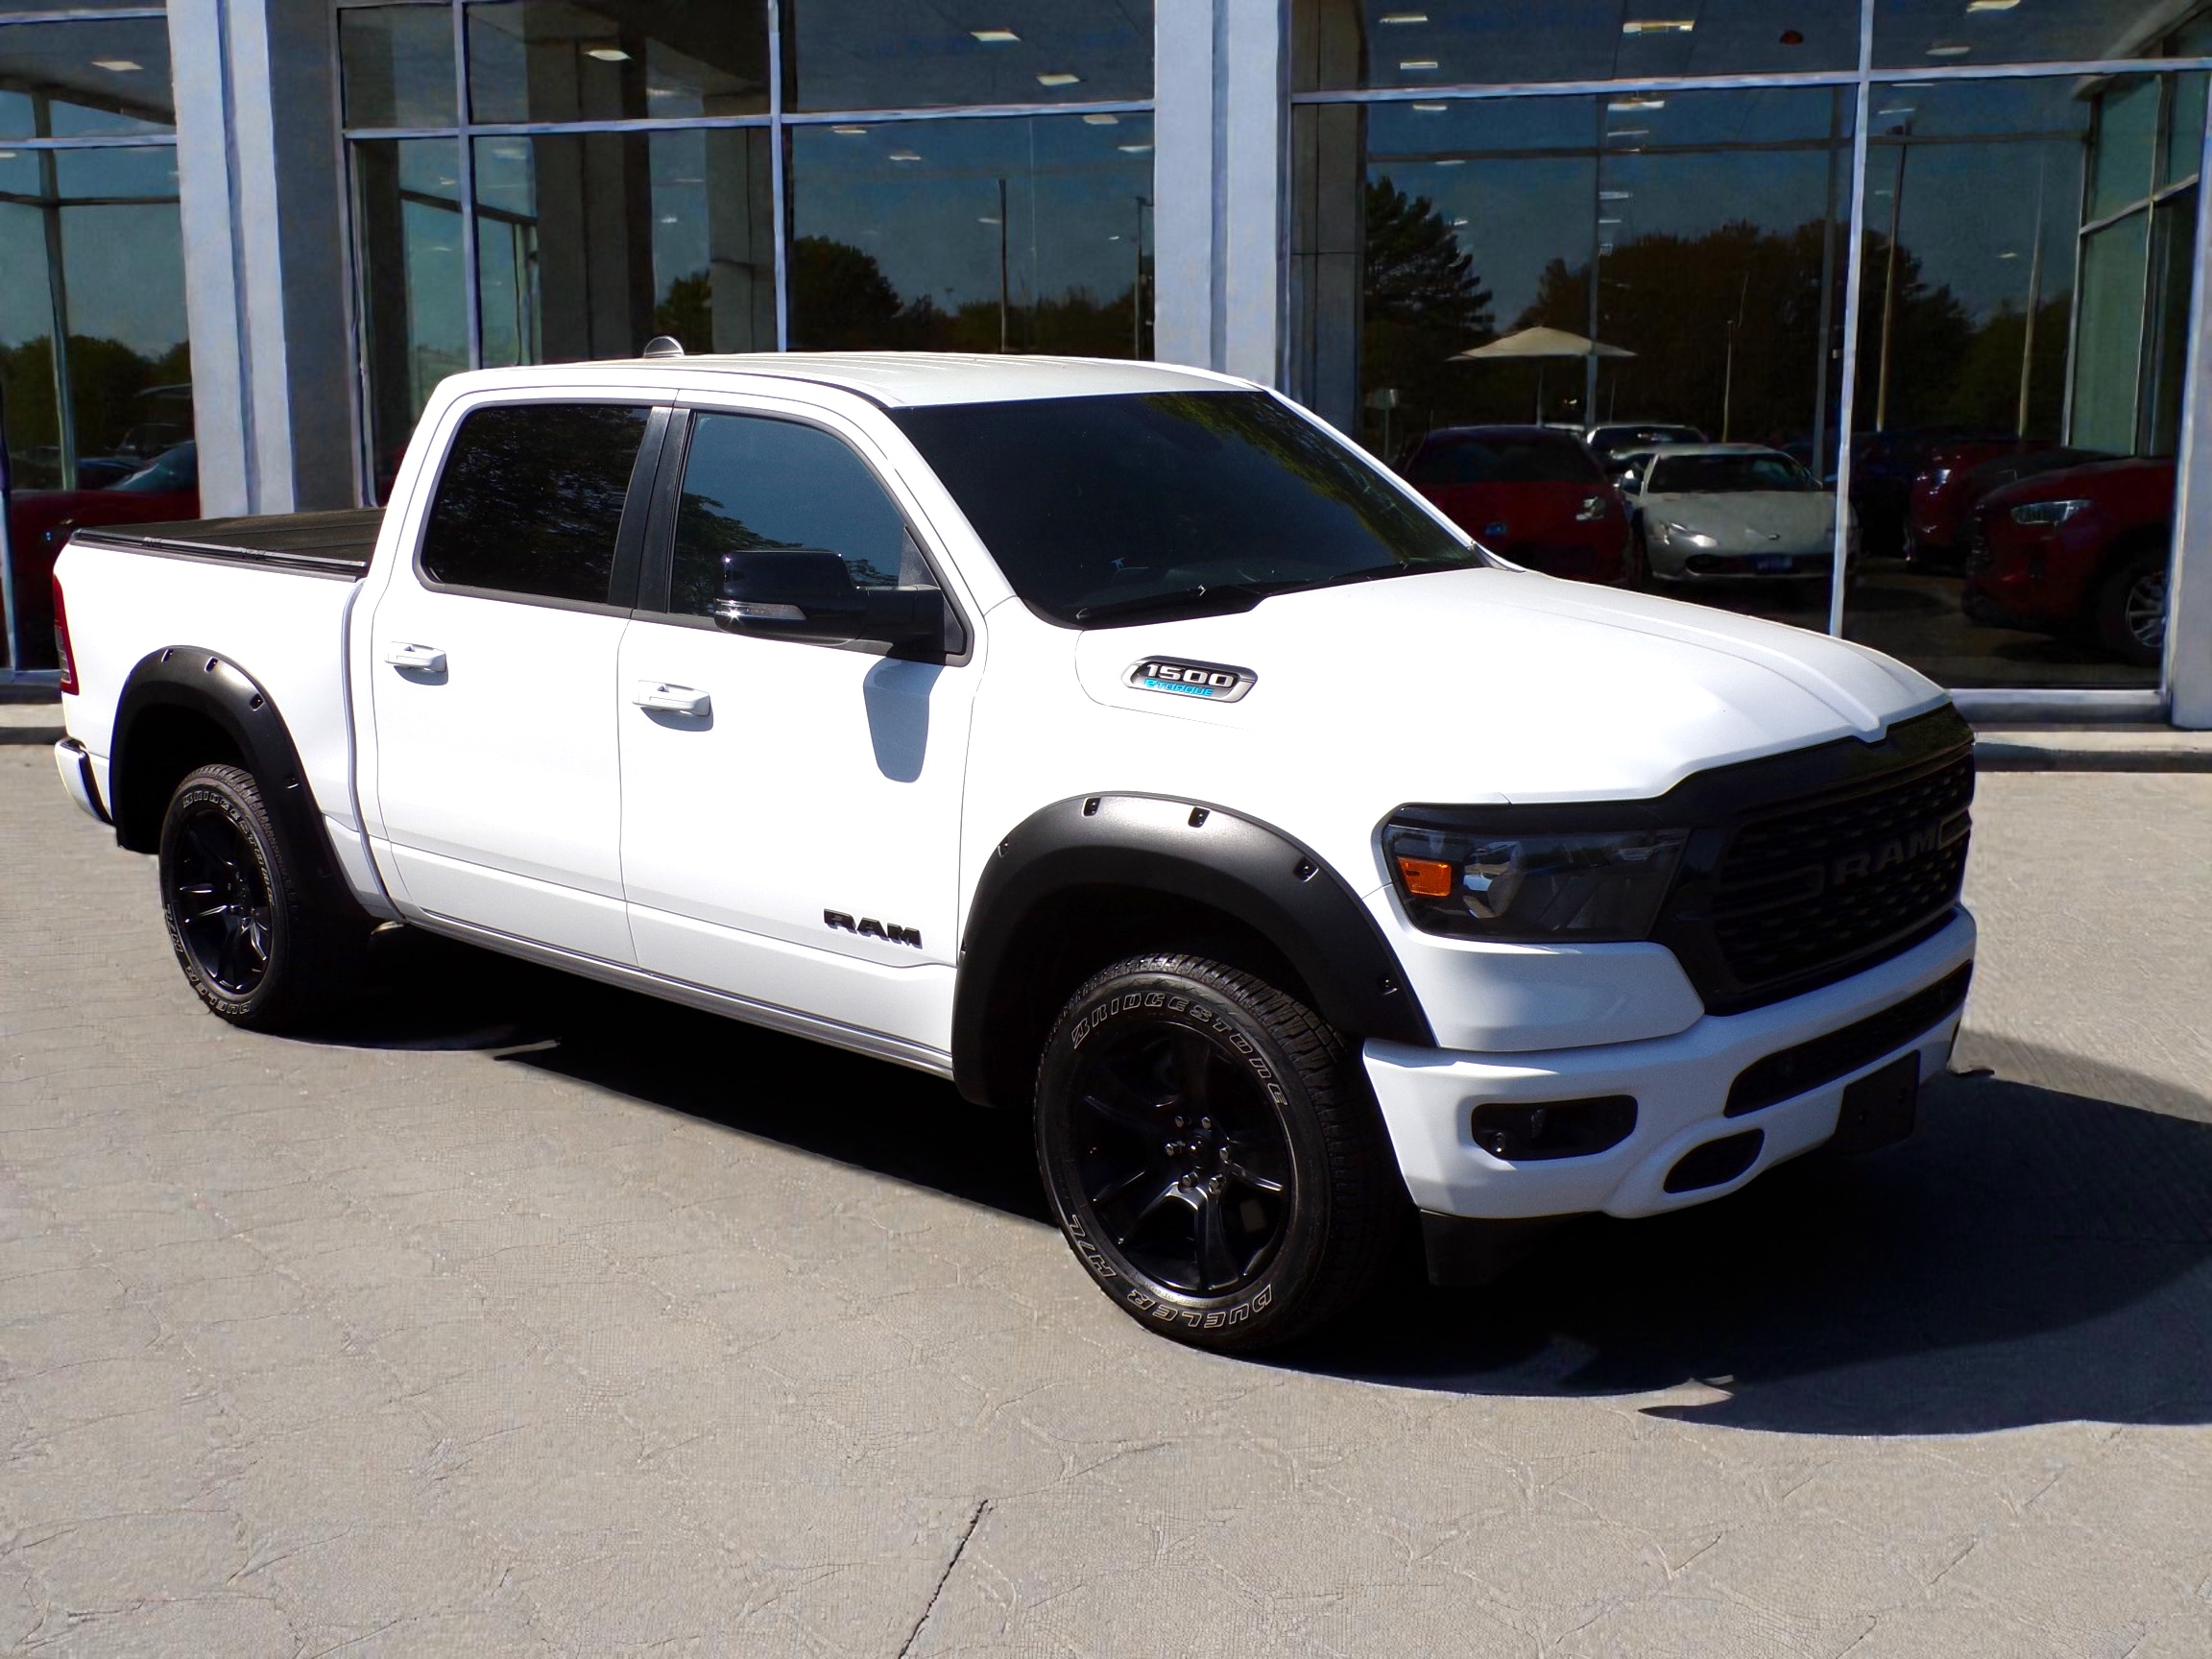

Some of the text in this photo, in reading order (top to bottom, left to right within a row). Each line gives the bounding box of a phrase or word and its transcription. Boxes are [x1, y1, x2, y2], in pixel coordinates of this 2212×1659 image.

[1146, 663, 1235, 687] 1500
[1832, 826, 1937, 886] RAM
[824, 908, 923, 950] RAM
[1070, 992, 1288, 1107] BRIDGESTONE
[1126, 1284, 1275, 1329] DUELER
